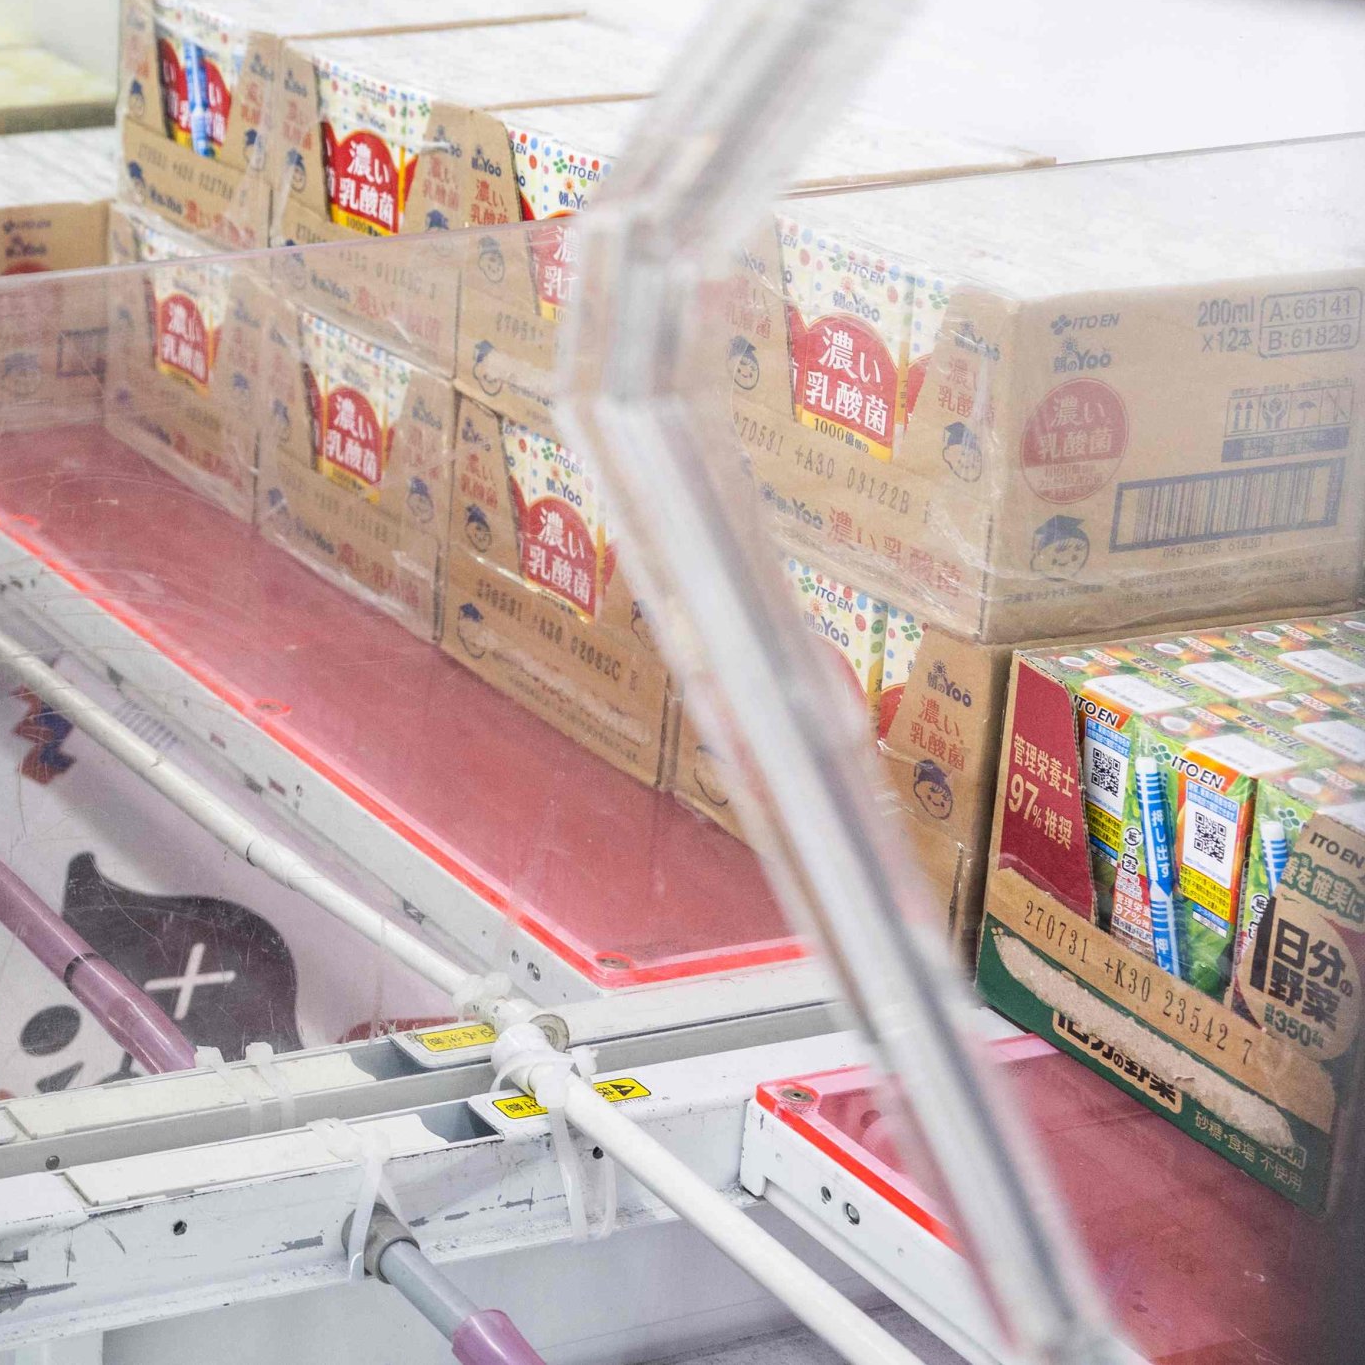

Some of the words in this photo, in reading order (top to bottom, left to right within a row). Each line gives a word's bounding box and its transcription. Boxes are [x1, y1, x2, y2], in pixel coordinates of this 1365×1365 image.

[347, 140, 391, 184] 濃い
[339, 177, 394, 230] 乳酸菌
[1072, 315, 1098, 331] ITO
[1100, 313, 1119, 327] EN
[1197, 296, 1254, 327] 200ml
[818, 325, 882, 383] 濃い
[335, 394, 373, 441] 濃い
[805, 370, 889, 437] 乳酸菌
[1050, 393, 1107, 427] 濃い
[326, 430, 378, 484] 乳酸菌
[795, 445, 835, 480] +A30
[1039, 426, 1112, 459] 乳酸菌
[539, 507, 585, 560] 濃い
[529, 546, 591, 605] 乳酸菌
[815, 585, 837, 604] ITO
[837, 597, 854, 614] EN
[921, 695, 960, 738] 濃い
[1074, 694, 1098, 717] ITO
[1097, 706, 1119, 728] EN
[910, 722, 965, 772] 乳酸菌
[1013, 730, 1076, 799] 管理栄養士
[1170, 754, 1200, 778] ITO
[1200, 770, 1226, 790] EN
[1007, 772, 1044, 831] 97%
[1043, 805, 1075, 852] 推奨
[1150, 808, 1171, 879] 押し出す
[1310, 831, 1341, 857] ITO
[1339, 848, 1365, 869] EN
[1023, 899, 1088, 964] 270731
[1103, 956, 1152, 1003] +K30
[1162, 989, 1229, 1051] 23542
[1242, 1038, 1254, 1066] 7
[1269, 960, 1341, 1032] 野菜
